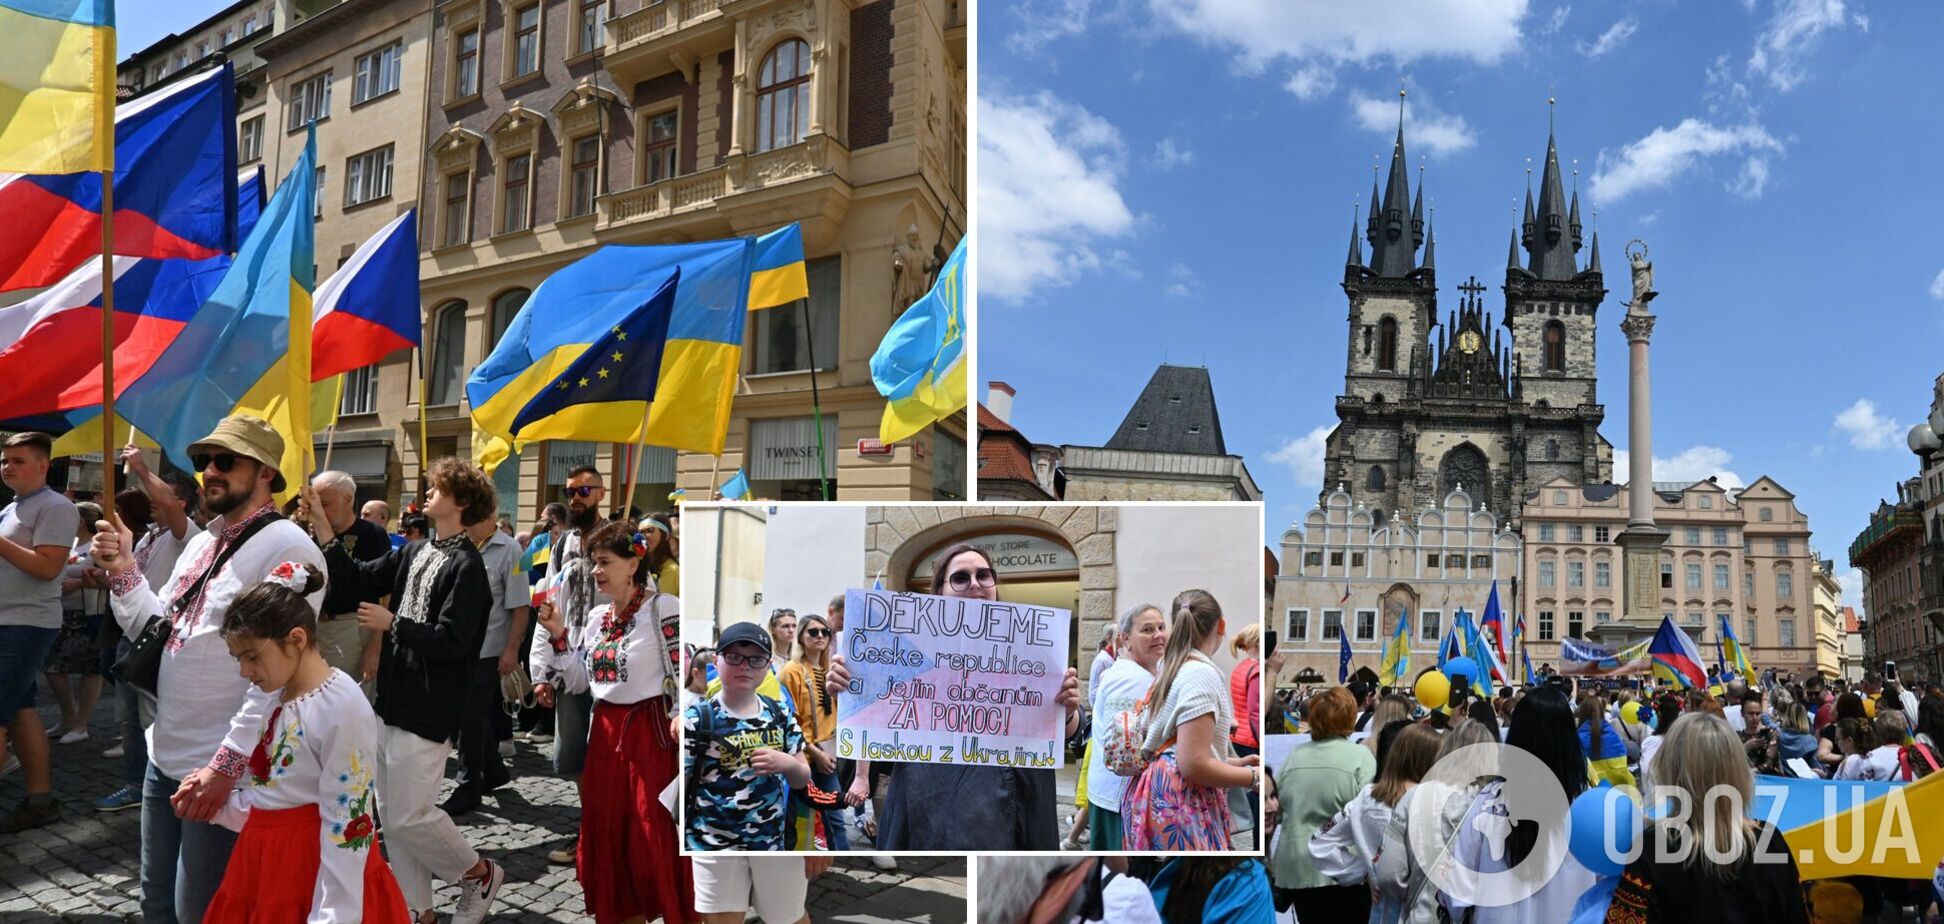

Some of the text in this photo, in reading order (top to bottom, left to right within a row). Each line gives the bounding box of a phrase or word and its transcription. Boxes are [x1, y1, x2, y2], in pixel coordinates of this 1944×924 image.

[552, 454, 593, 465] TWINSET
[765, 446, 821, 459] TWINSET
[992, 553, 1057, 567] HOCOLATE
[1001, 540, 1031, 551] STORE
[864, 591, 1055, 647] DĚKUJEME
[934, 644, 1046, 679] republice
[847, 677, 863, 695] a
[947, 679, 1043, 707] občanům
[888, 700, 1011, 736] ZA POMOC!
[840, 728, 1056, 768] S laskou z Ukrajinu!
